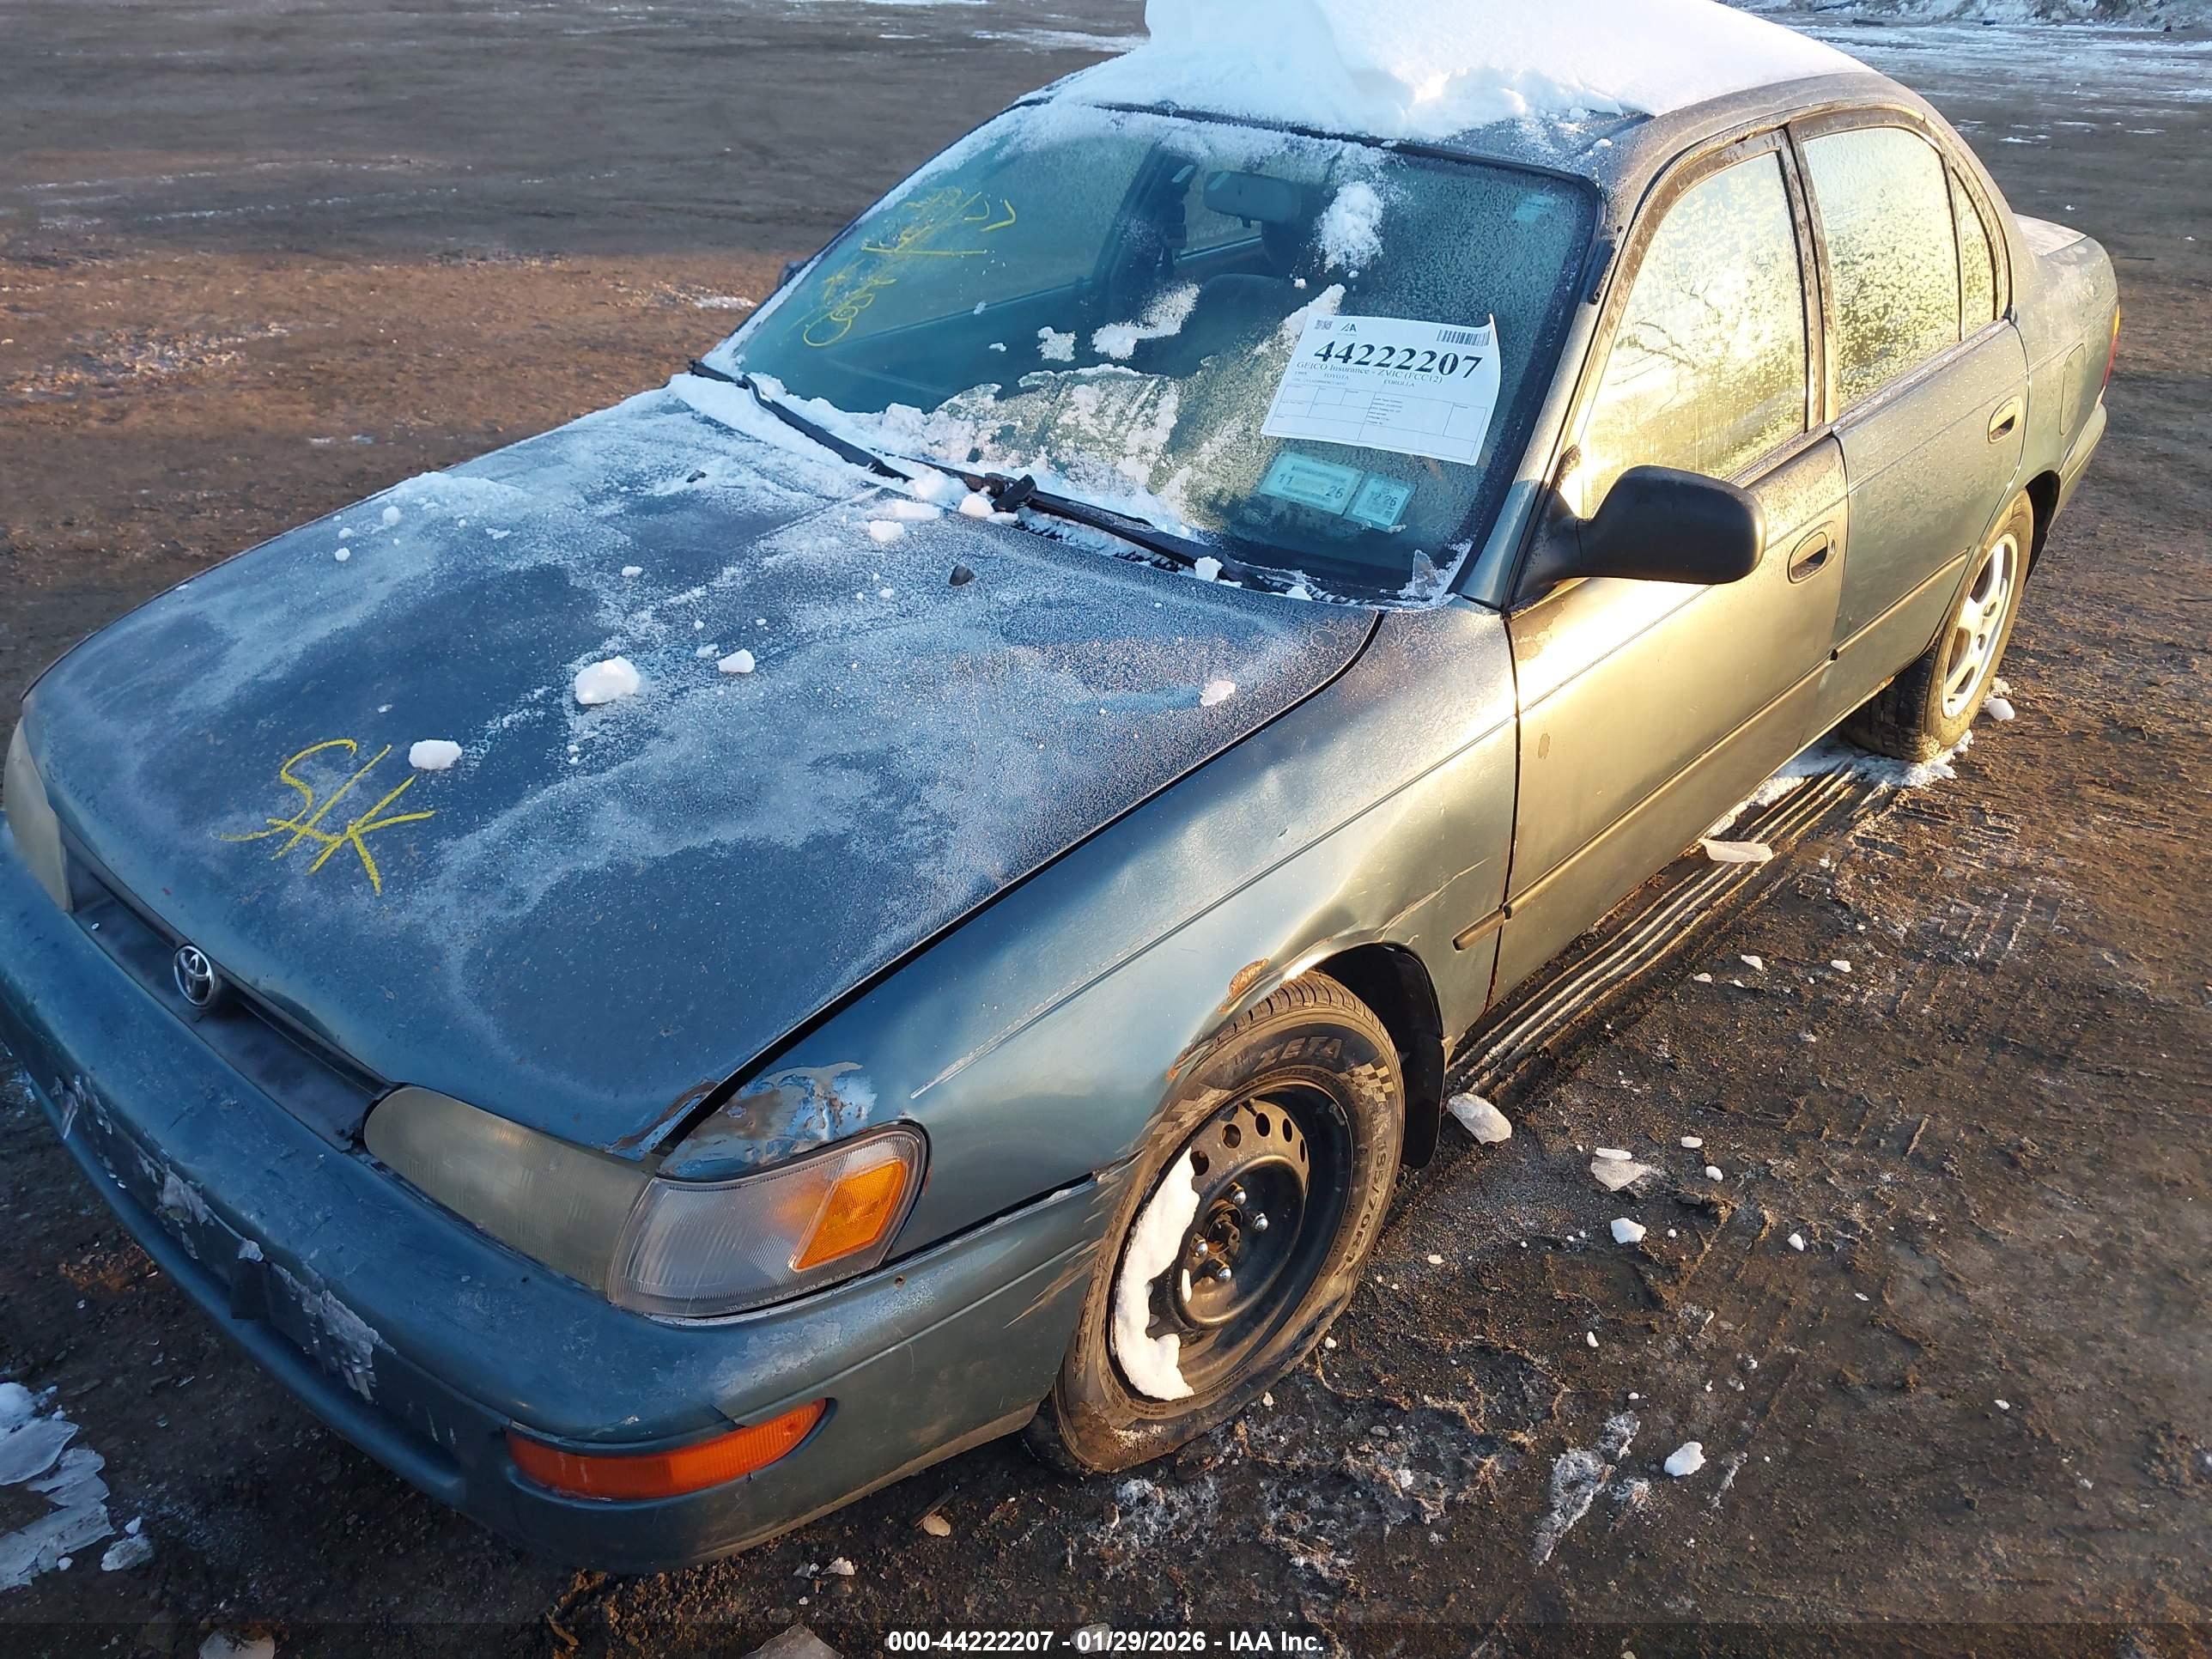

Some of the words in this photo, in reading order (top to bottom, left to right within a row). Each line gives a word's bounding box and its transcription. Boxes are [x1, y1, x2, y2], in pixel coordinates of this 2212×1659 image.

[1297, 362, 1328, 371] GEICO
[1329, 364, 1370, 374] Insurance
[1314, 340, 1484, 379] 44222207
[1383, 379, 1415, 387] COROLLA
[1253, 1036, 1342, 1073] ZETA
[1334, 1139, 1387, 1278] 185/70R1
